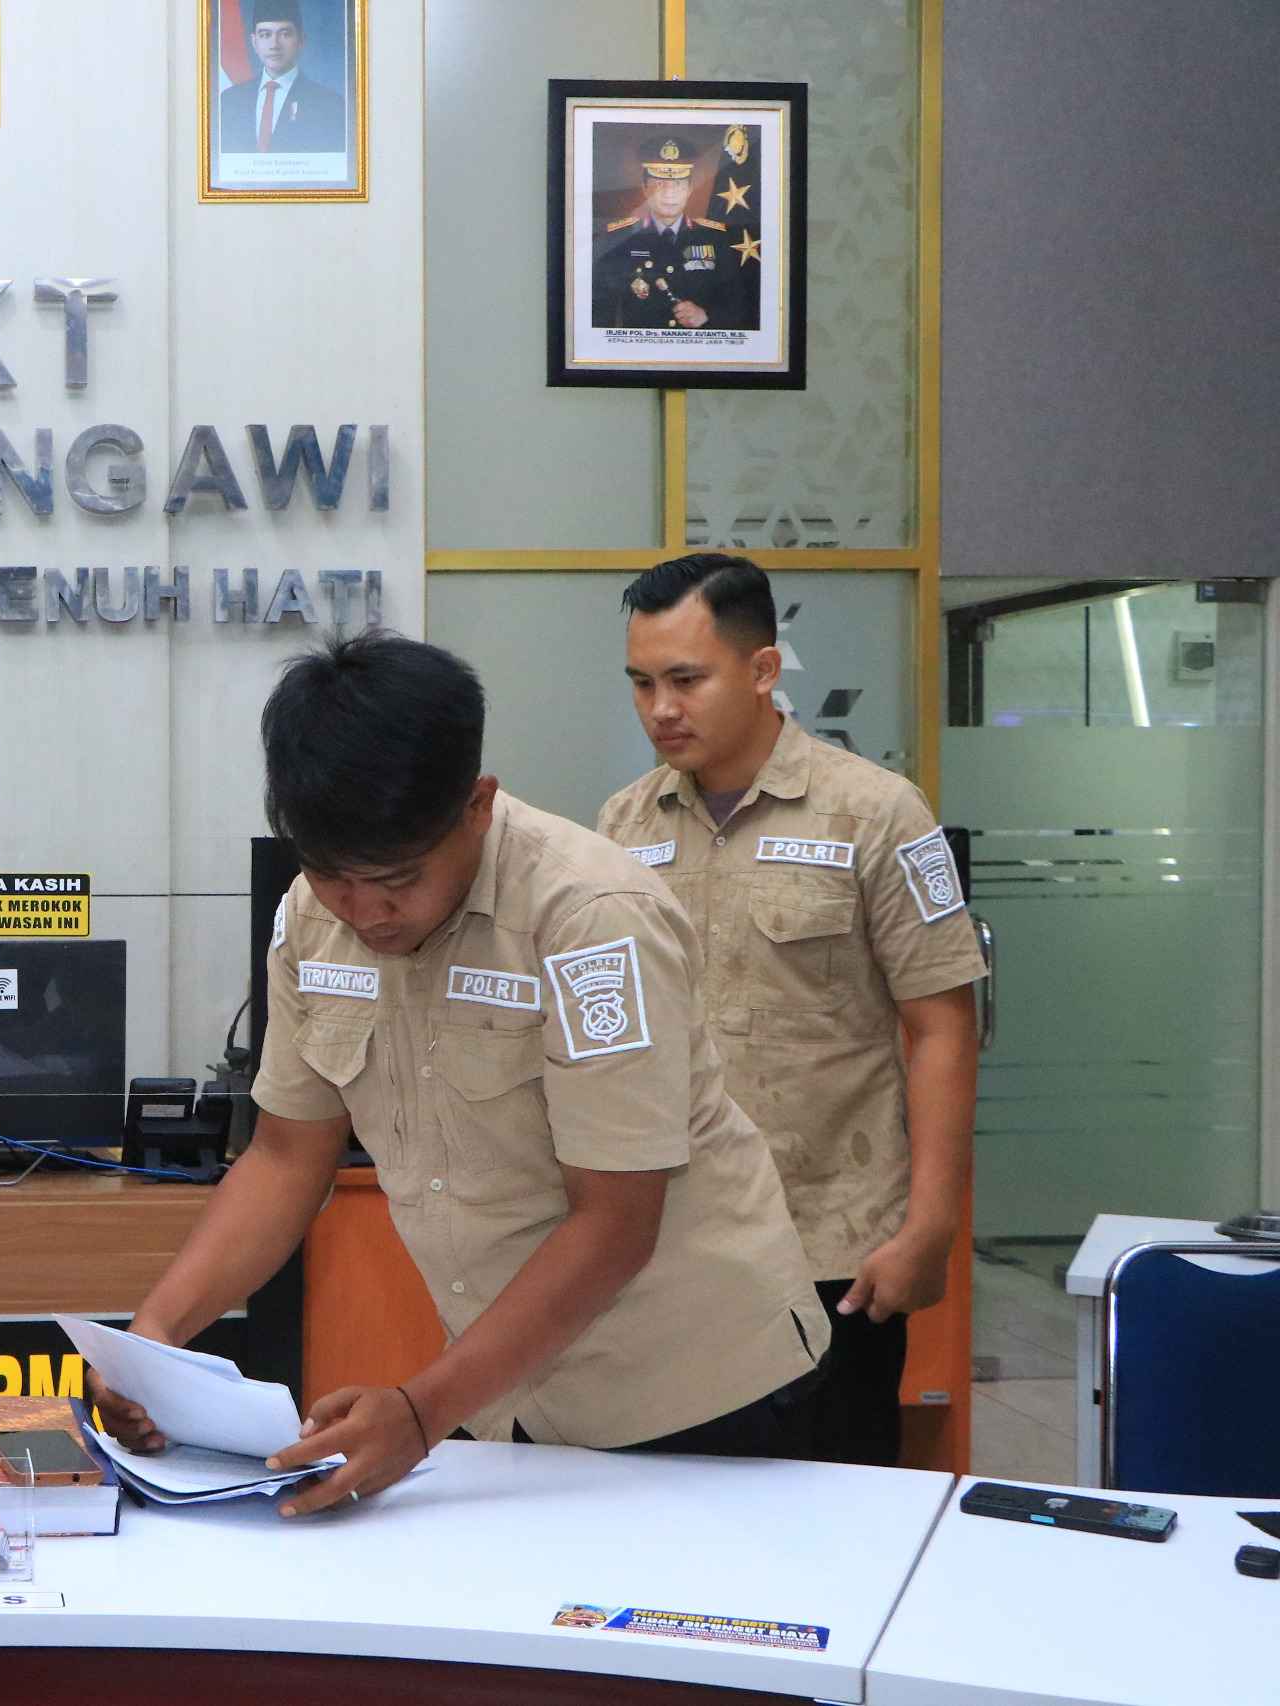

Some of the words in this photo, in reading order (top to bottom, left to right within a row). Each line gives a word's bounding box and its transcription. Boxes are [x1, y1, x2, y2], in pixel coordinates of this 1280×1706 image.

[212, 567, 383, 624] HATI
[772, 842, 836, 861] POLRI
[14, 878, 81, 891] KASIH
[8, 899, 82, 912] MEROKOK
[57, 917, 79, 929] INI
[303, 968, 375, 991] TRIYATNO
[462, 974, 519, 1001] POLRI
[631, 1615, 679, 1627] TIDAK
[768, 1628, 819, 1640] BIAYA
